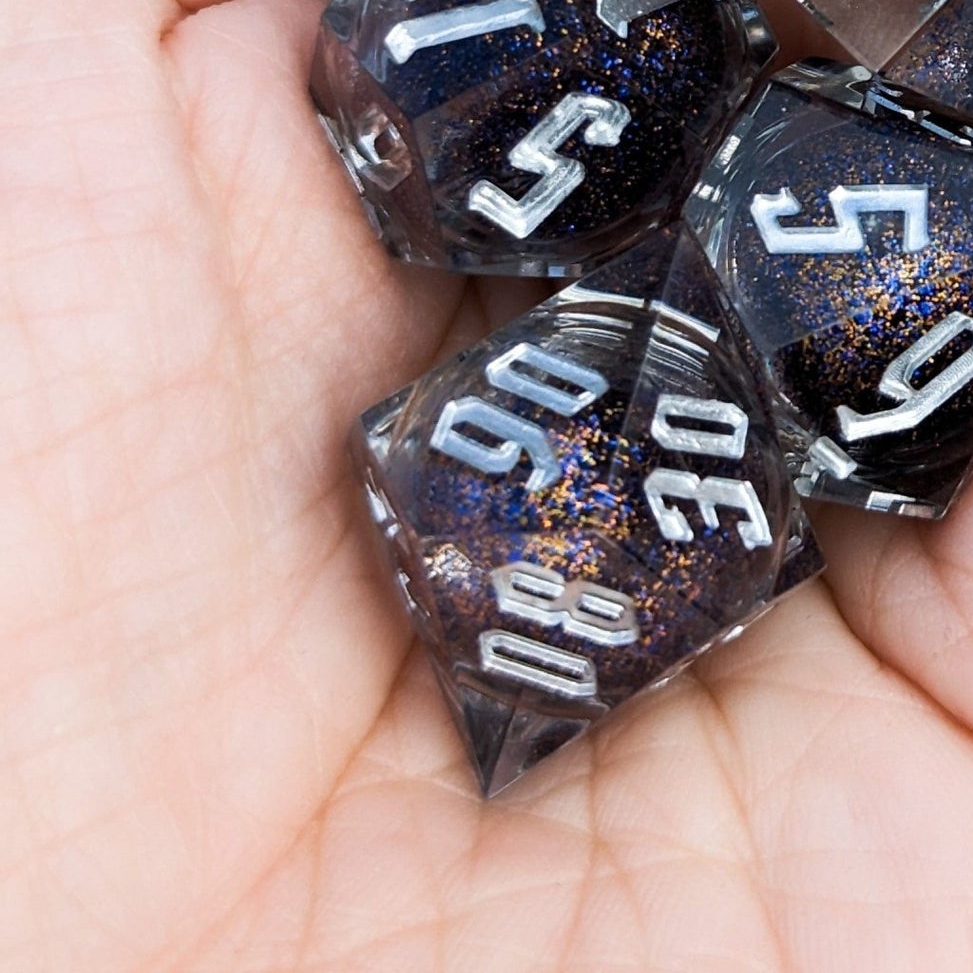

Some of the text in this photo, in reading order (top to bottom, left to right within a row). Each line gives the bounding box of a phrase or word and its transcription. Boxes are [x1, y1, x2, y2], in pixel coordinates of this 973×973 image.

[469, 92, 631, 239] 5
[750, 184, 930, 254] 5
[430, 342, 609, 491] 90
[644, 394, 773, 550] 30
[479, 561, 640, 698] 80
